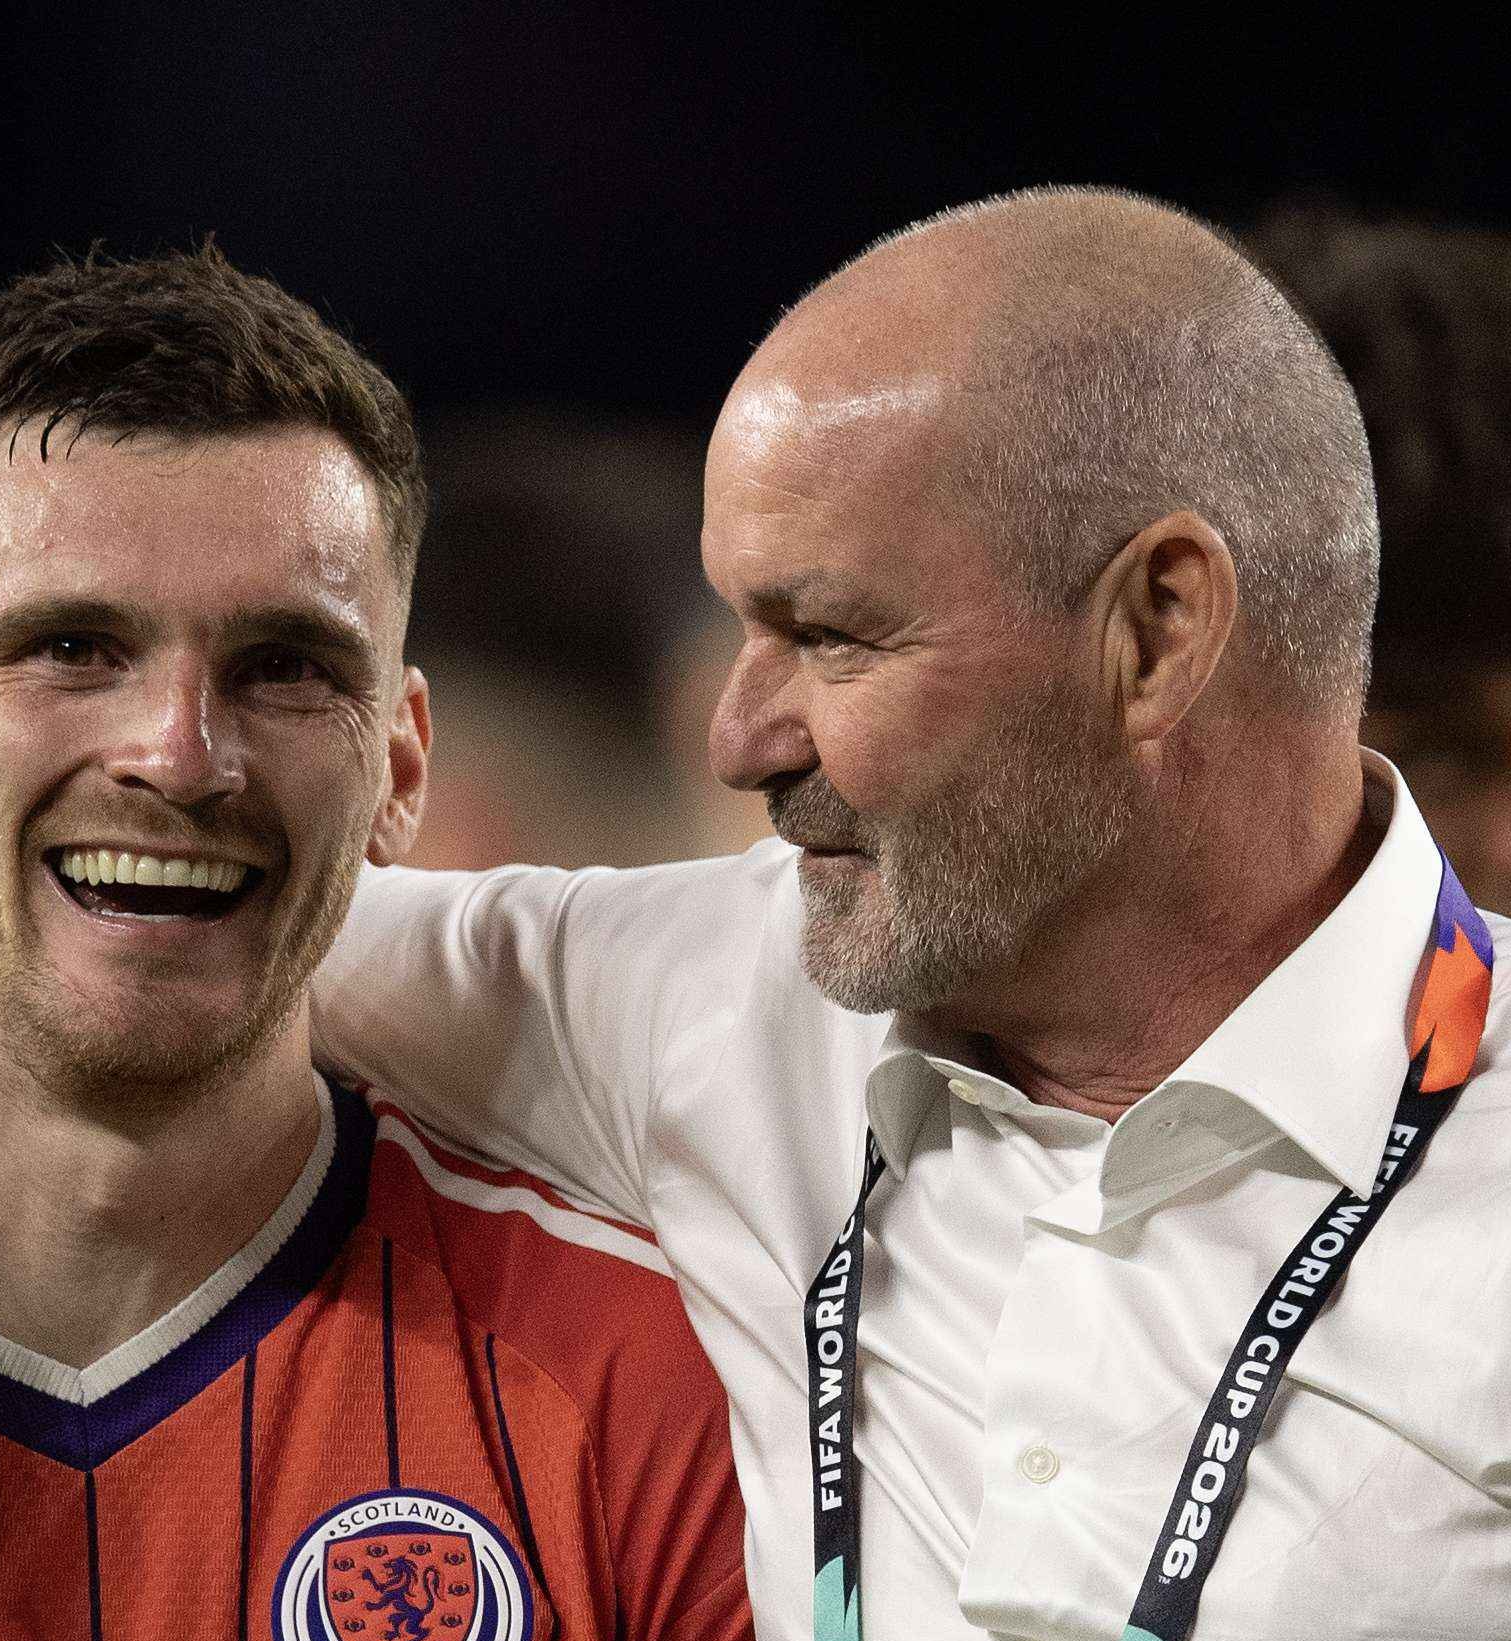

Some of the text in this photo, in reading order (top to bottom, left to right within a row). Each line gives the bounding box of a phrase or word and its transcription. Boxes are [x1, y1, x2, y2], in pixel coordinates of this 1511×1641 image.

[814, 1245, 853, 1400] WORLD
[1162, 1123, 1419, 1580] FIF WORLD CUP 2026
[338, 1502, 455, 1533] SCOTLAND
[819, 1410, 842, 1512] FIFA
